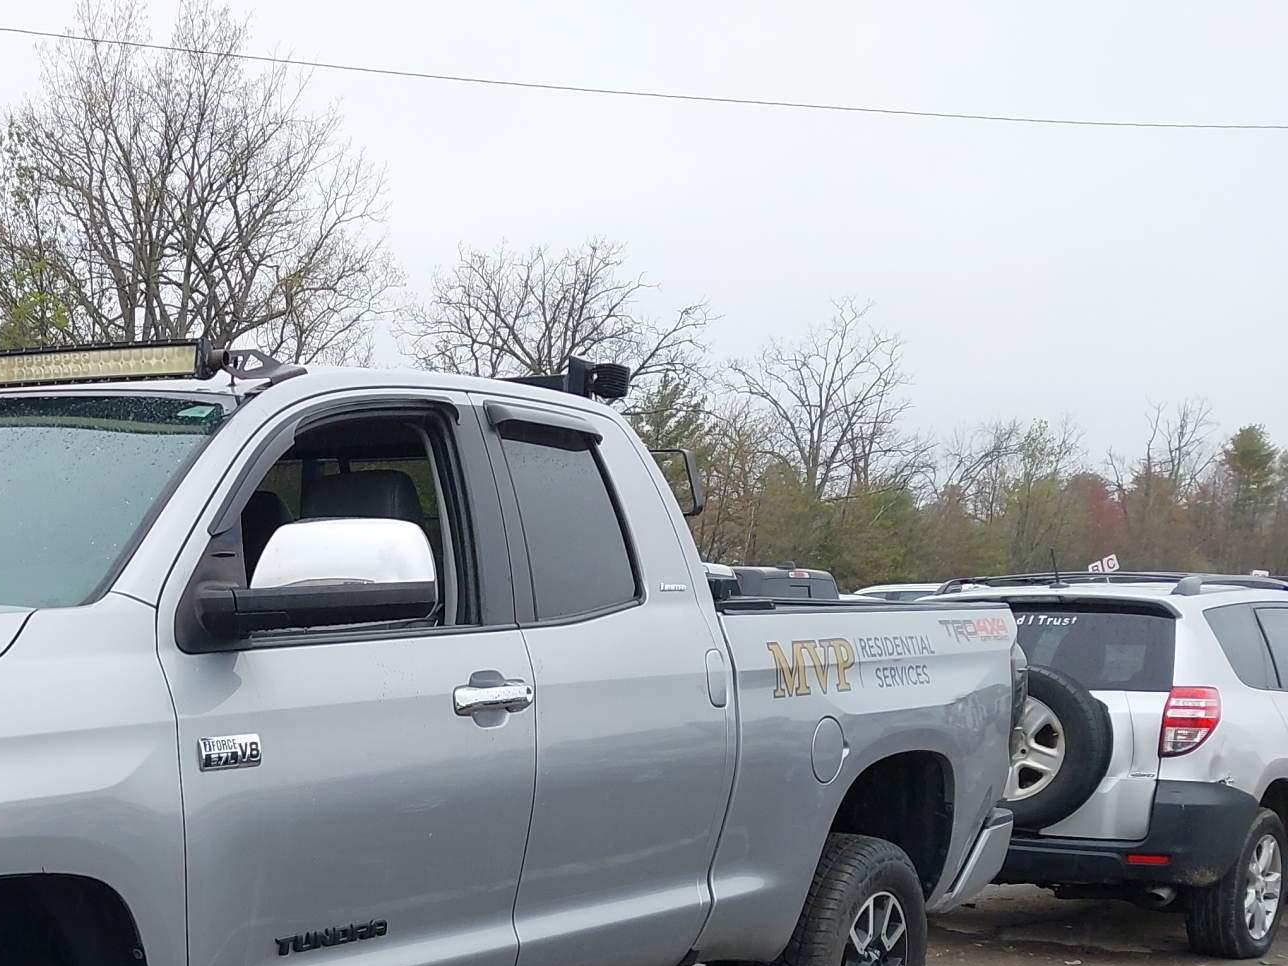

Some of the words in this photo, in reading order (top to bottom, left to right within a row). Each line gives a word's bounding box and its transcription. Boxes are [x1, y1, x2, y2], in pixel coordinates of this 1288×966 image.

[1038, 615, 1078, 626] Trust
[860, 635, 936, 659] RESIDENTIAL
[767, 637, 856, 698] MVP
[875, 664, 931, 689] SERVICES
[239, 741, 260, 761] V8
[274, 919, 388, 957] TUNDRA
